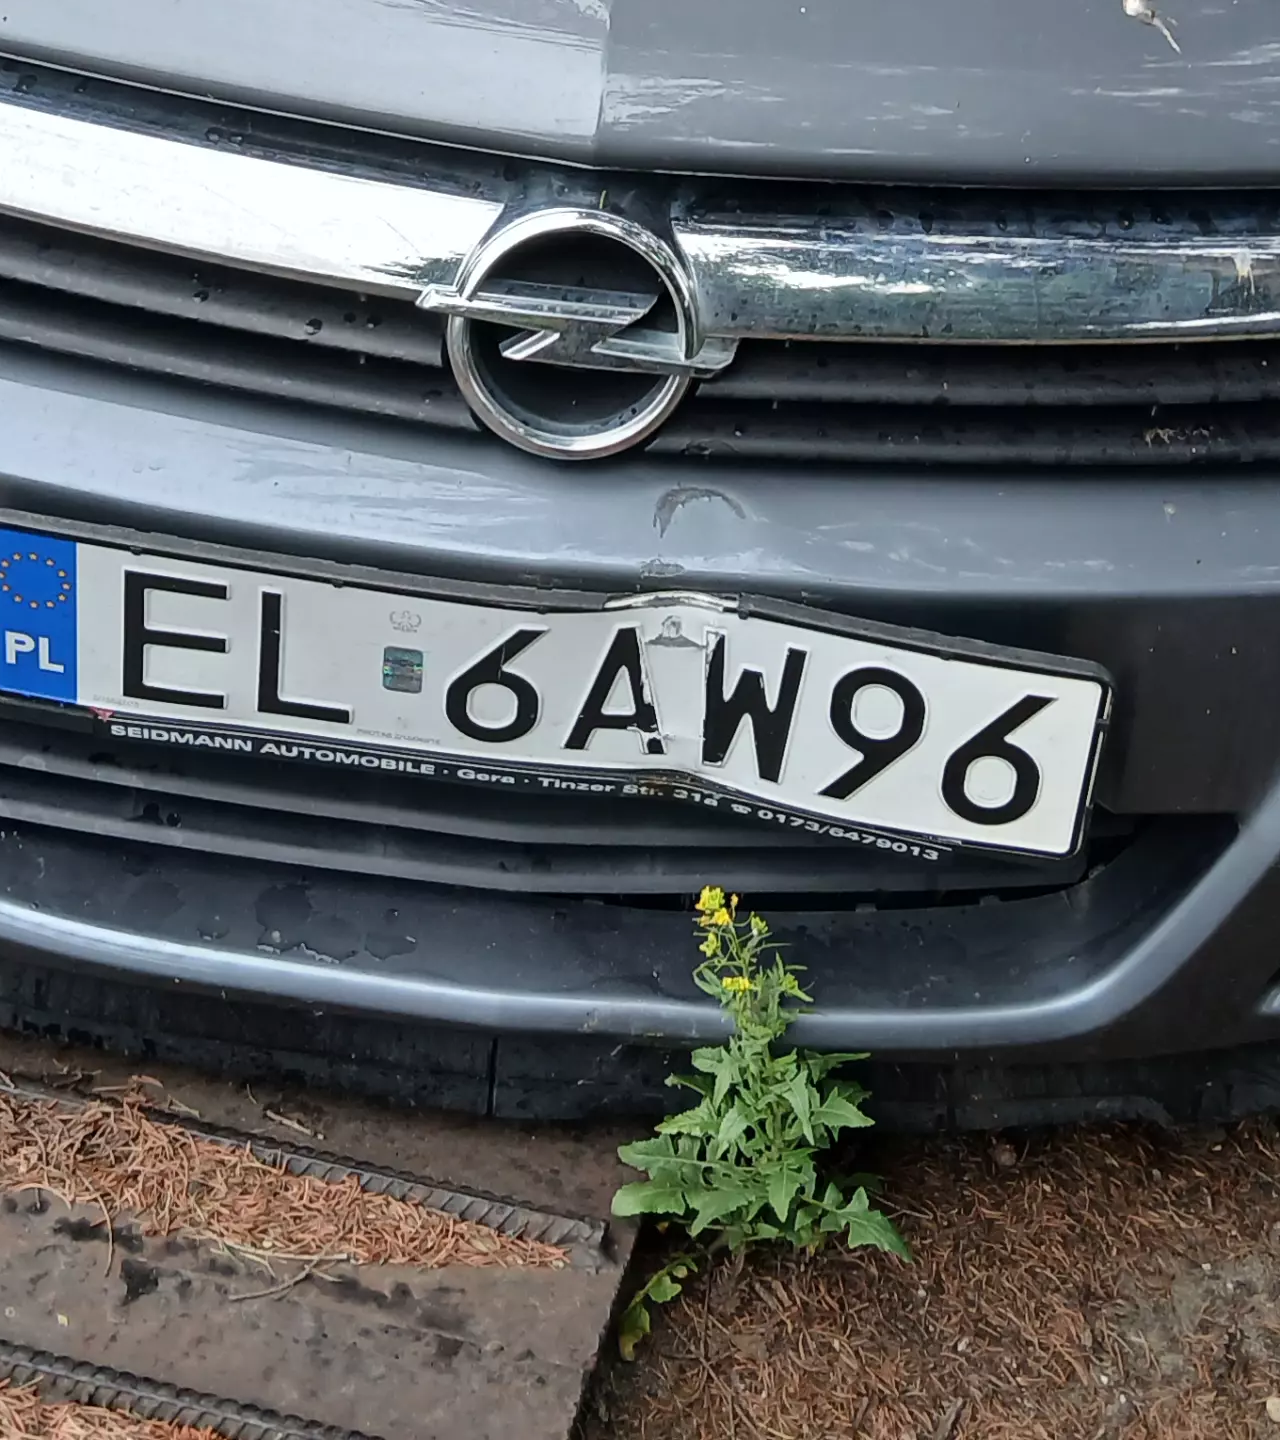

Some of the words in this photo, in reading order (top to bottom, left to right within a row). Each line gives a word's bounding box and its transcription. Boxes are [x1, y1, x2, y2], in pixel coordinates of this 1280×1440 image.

[5, 630, 65, 676] PL
[122, 570, 354, 724] EL
[444, 627, 1054, 826] 6AW96
[110, 724, 253, 753] SEIDMANN
[260, 741, 436, 777] AUTOMOBILE
[456, 767, 516, 786] Gera
[538, 776, 616, 795] Tinzer
[622, 783, 664, 797] Str.
[757, 809, 940, 861] 0173/6479013
